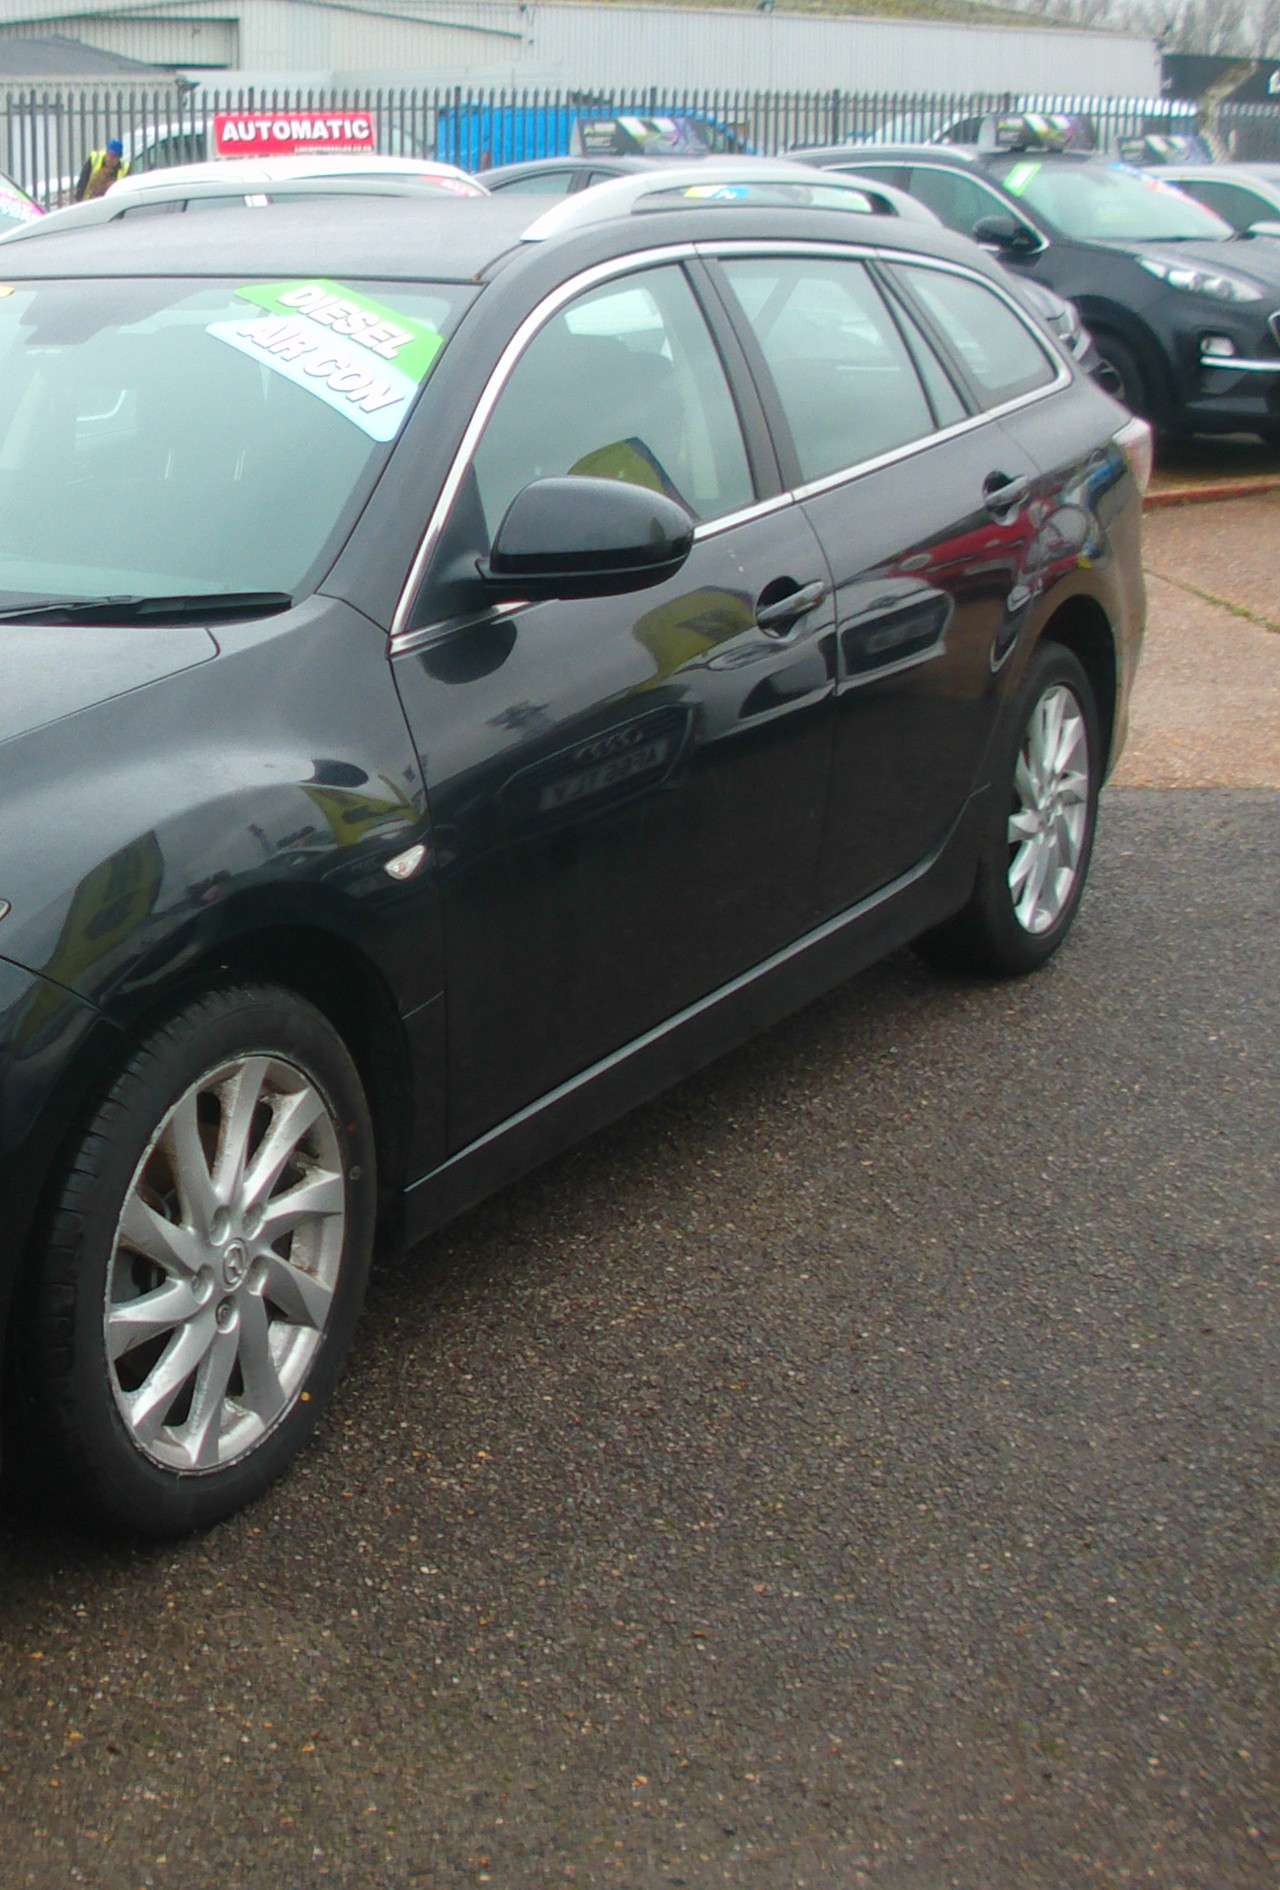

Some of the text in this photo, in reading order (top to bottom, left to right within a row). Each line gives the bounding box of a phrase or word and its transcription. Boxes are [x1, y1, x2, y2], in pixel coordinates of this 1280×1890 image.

[222, 119, 370, 142] AUTOMATIC
[276, 284, 415, 361] DIESEL
[236, 316, 406, 414] AIR CON
